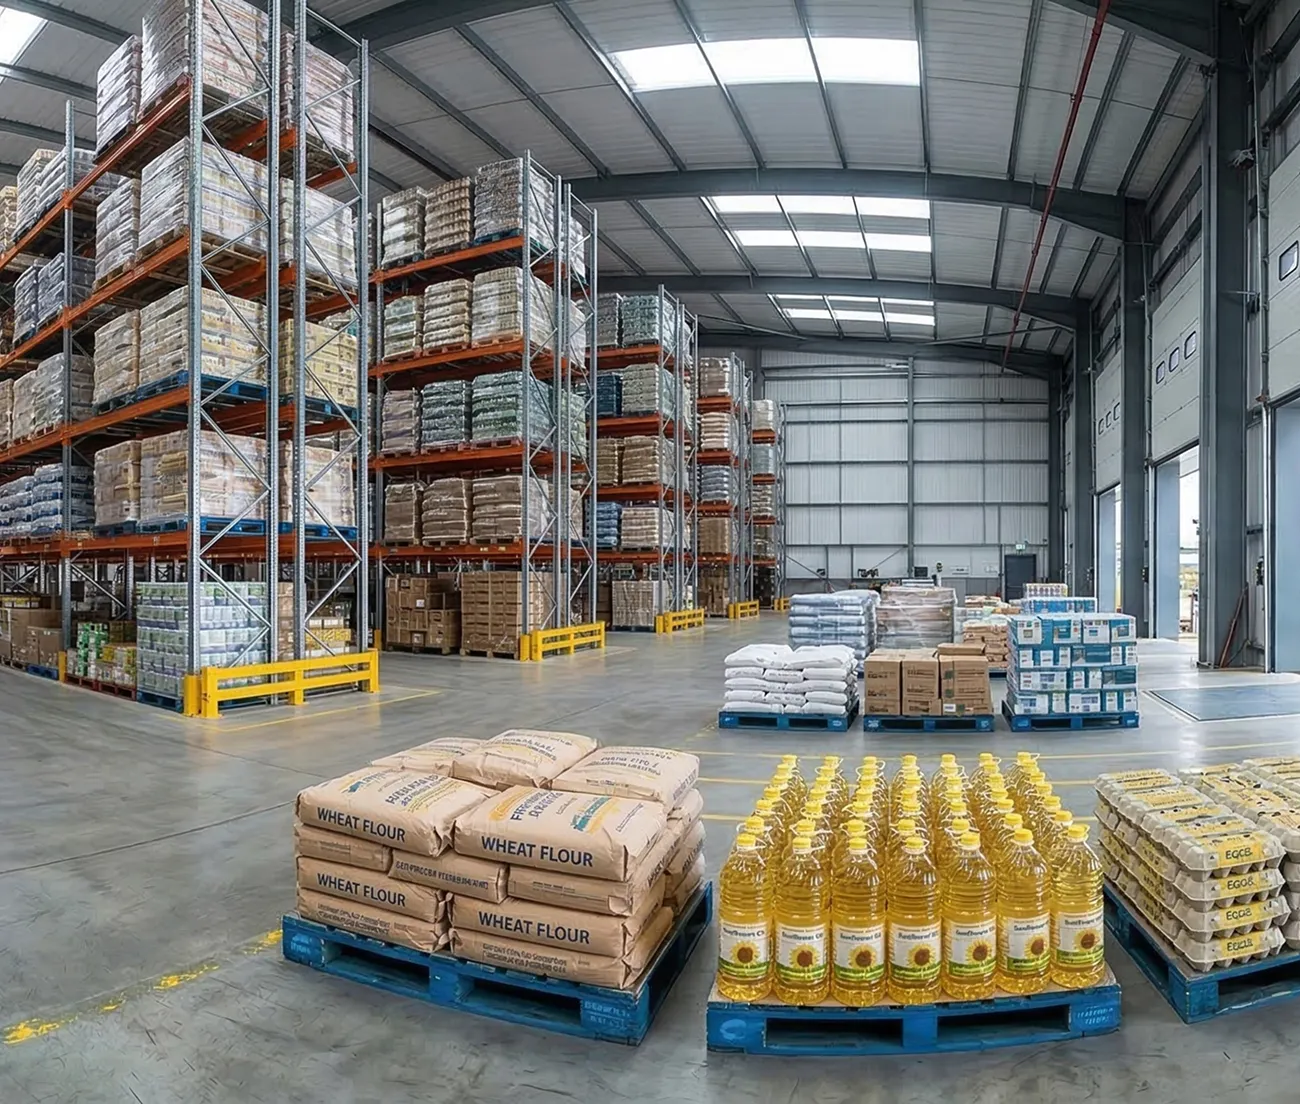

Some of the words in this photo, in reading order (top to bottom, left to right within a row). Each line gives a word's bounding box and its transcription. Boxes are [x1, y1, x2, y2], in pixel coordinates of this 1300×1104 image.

[317, 807, 359, 829] WHEAT
[363, 819, 406, 843] FLOUR
[481, 836, 536, 858] WHEAT
[540, 846, 593, 867] FLOUR
[317, 873, 360, 895] WHEAT
[363, 885, 406, 907] FLOUR
[478, 911, 533, 935] WHEAT
[536, 924, 590, 944] FLOUR
